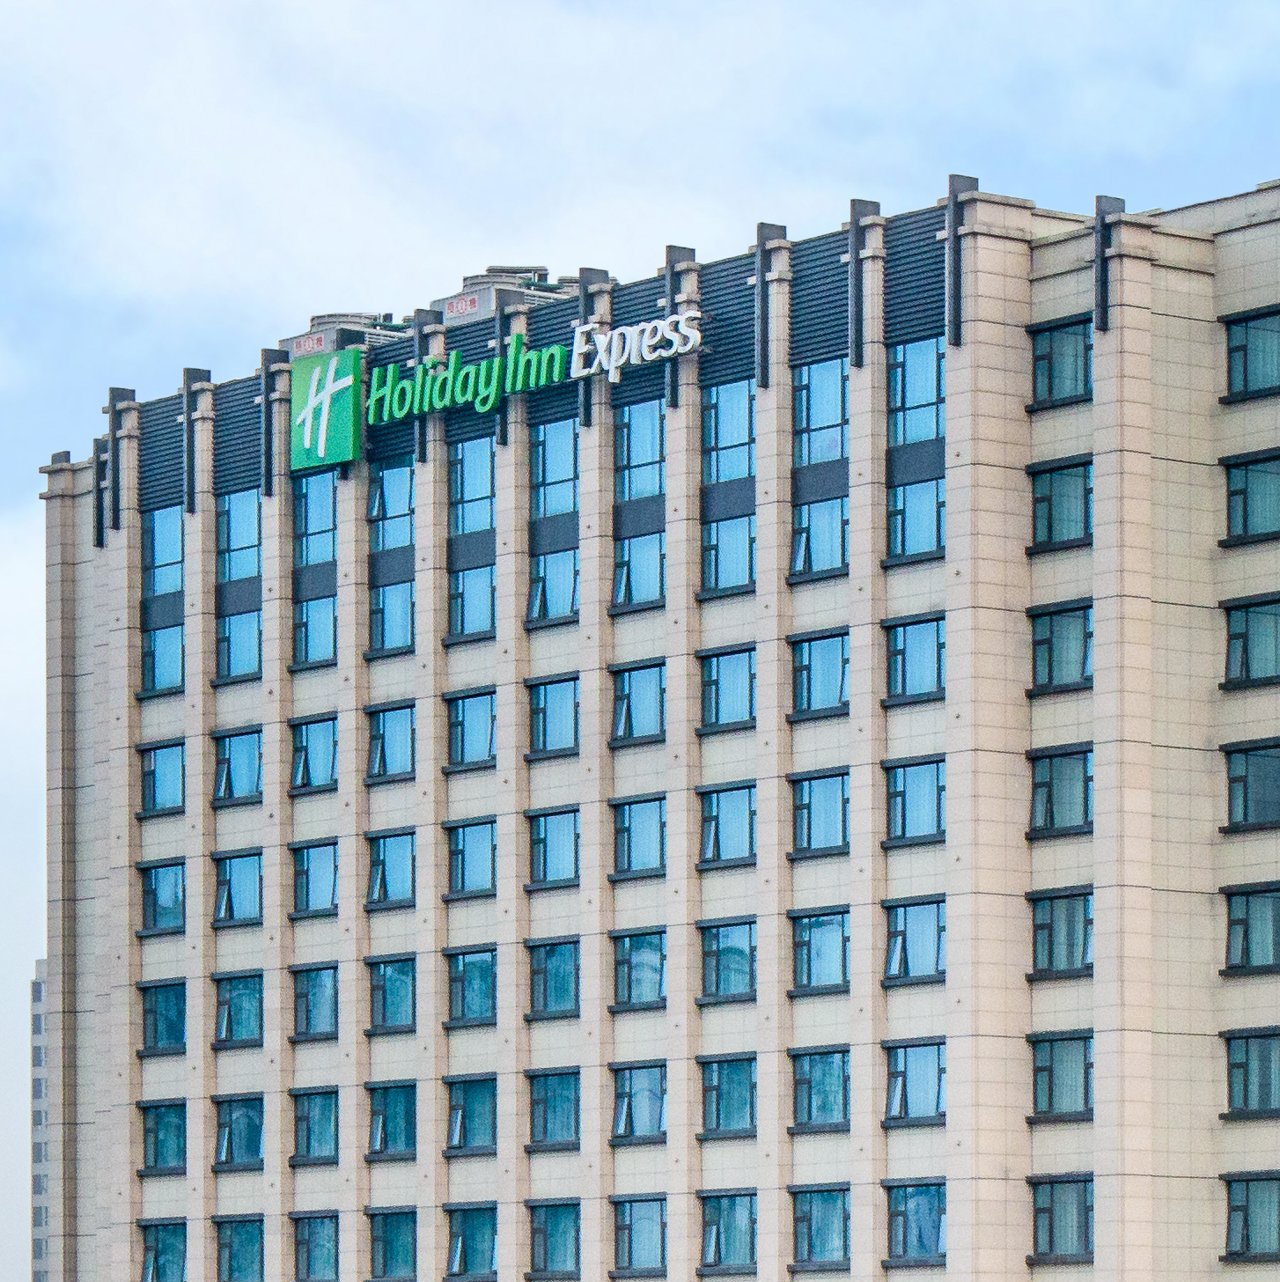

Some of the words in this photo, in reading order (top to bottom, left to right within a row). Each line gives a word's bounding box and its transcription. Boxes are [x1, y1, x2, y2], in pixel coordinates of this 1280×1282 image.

[367, 351, 503, 426] Holiday
[506, 333, 567, 394] Inn
[570, 310, 703, 383] Express
